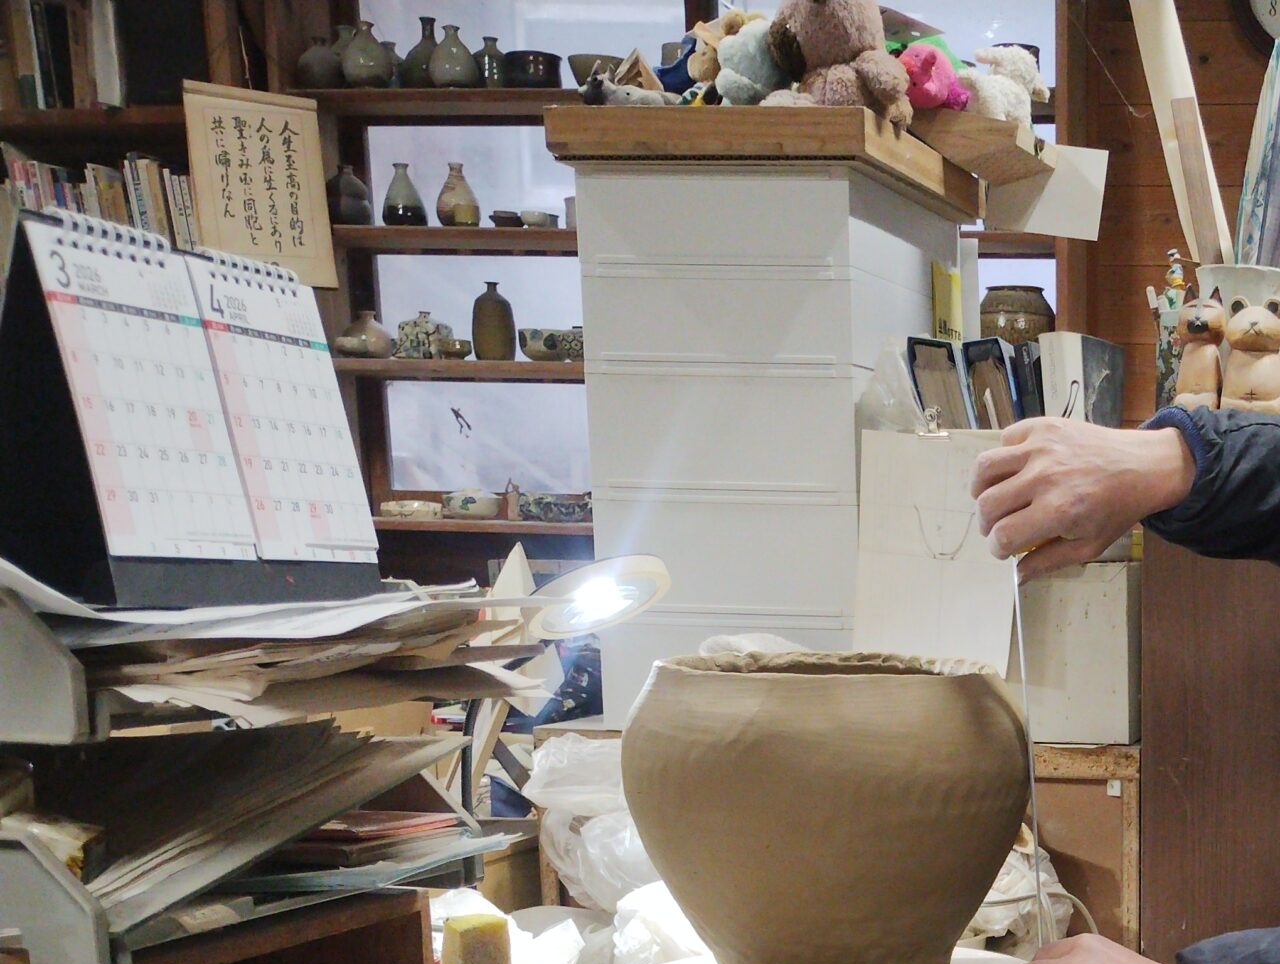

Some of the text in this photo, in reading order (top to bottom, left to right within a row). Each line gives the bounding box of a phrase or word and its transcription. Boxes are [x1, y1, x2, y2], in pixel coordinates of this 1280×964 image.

[49, 251, 72, 289] 3
[73, 263, 102, 283] 2026
[210, 284, 225, 319] 4
[224, 295, 247, 313] 2026
